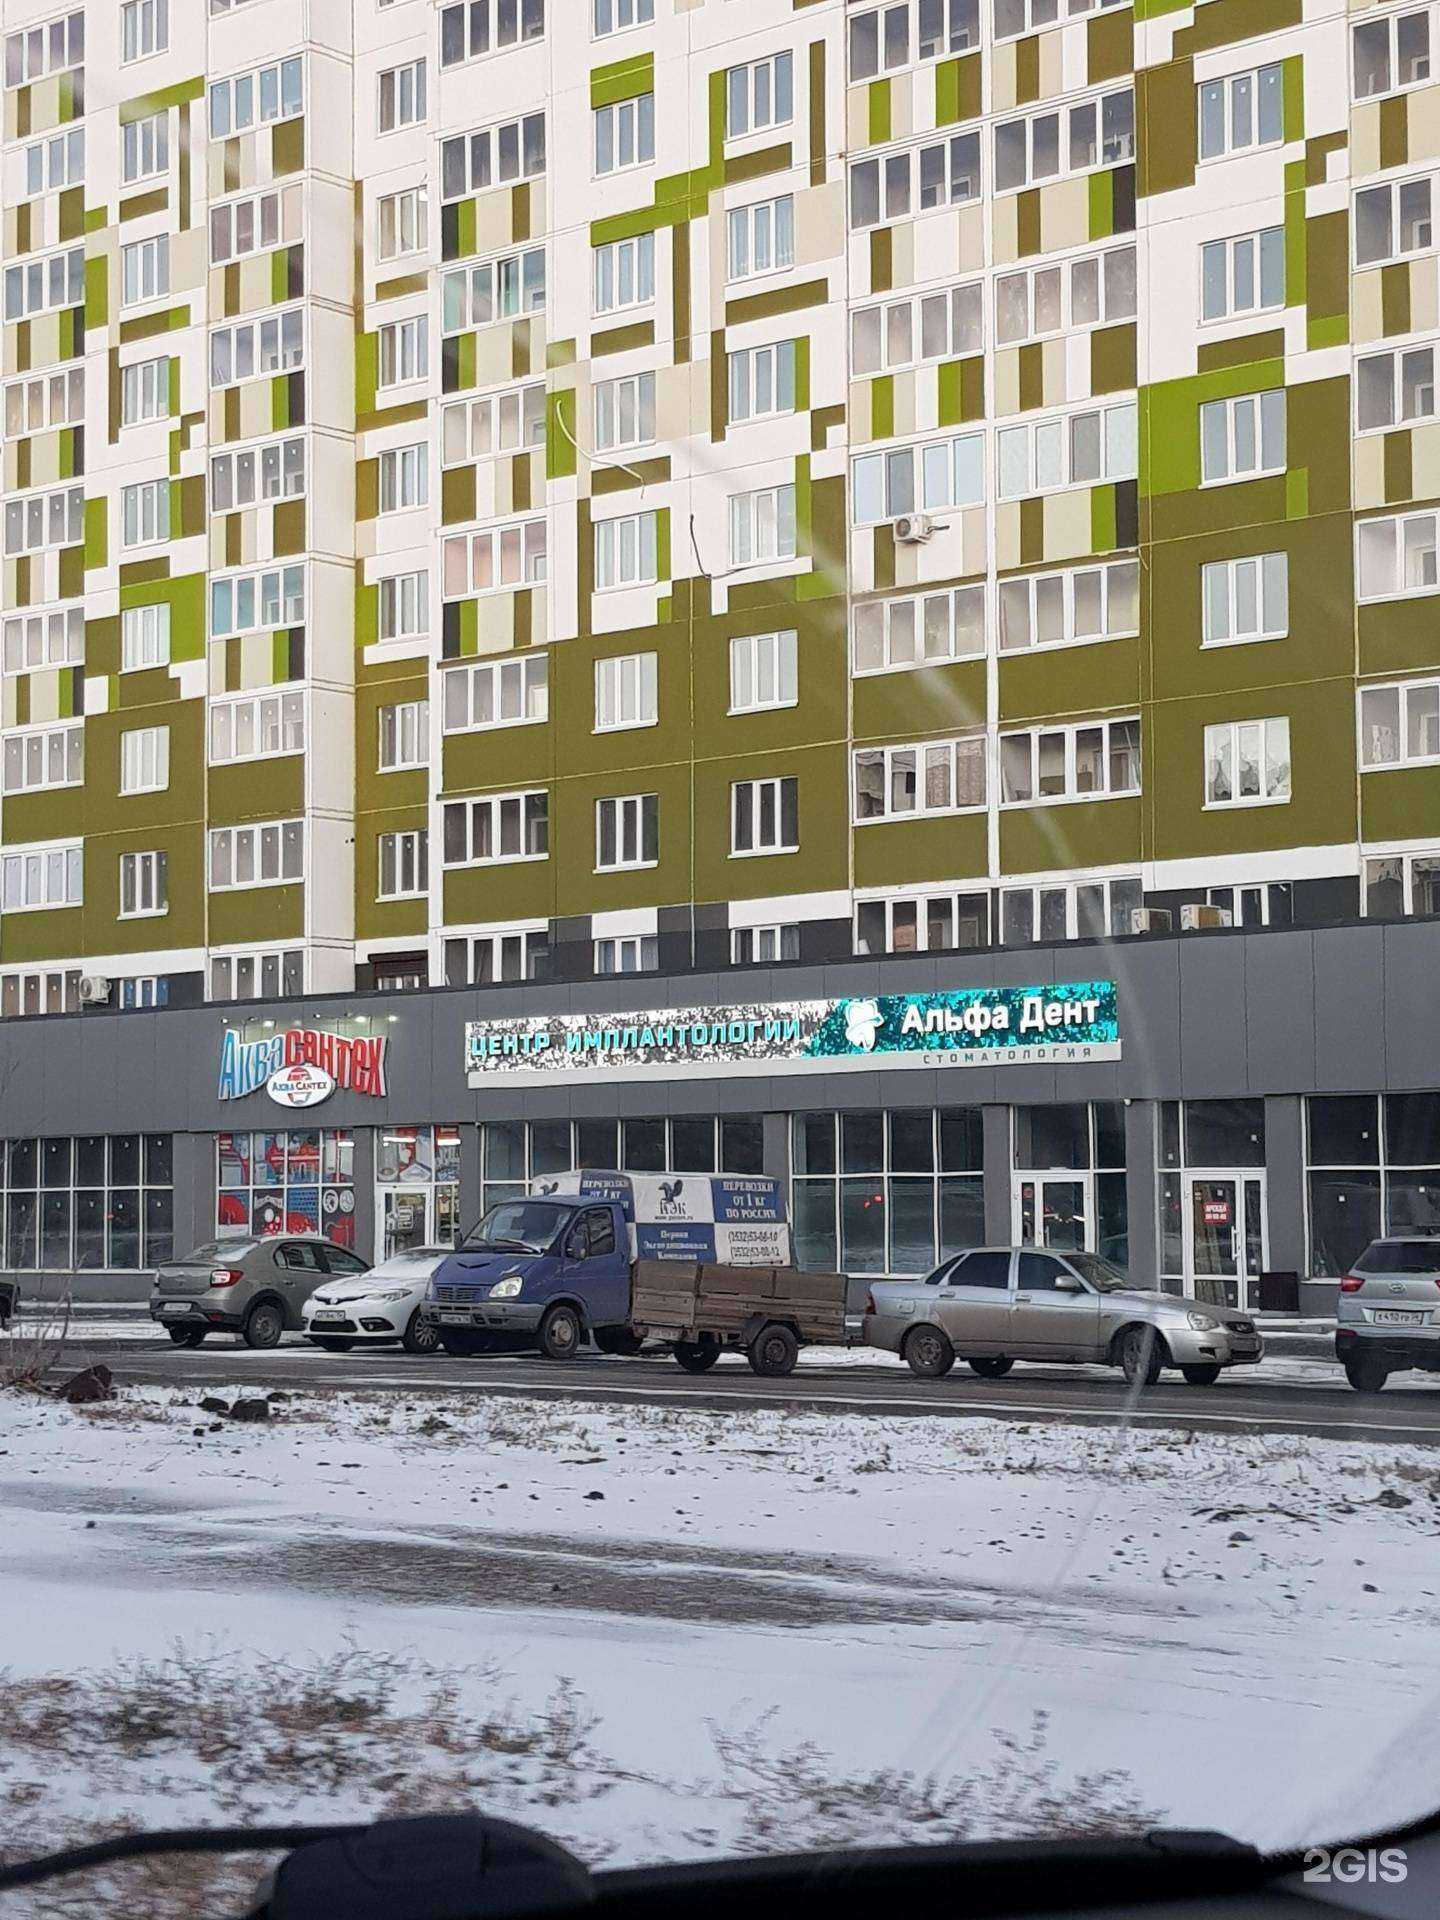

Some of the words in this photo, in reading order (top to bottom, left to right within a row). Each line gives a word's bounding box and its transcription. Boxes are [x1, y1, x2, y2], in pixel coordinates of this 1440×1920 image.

[901, 1001, 1009, 1037] Альфа
[1020, 996, 1100, 1033] Дент
[470, 1032, 550, 1057] ЦЕНТР
[566, 1017, 801, 1053] ИМПЛАНТОЛОГИИ
[923, 1047, 1092, 1064] СТОМАТОЛОГИЯ
[723, 1181, 774, 1192] ПЕРЕВОЗКИ
[747, 1193, 753, 1207] 1
[725, 1208, 739, 1218] ПО
[742, 1208, 776, 1219] РОССИИ
